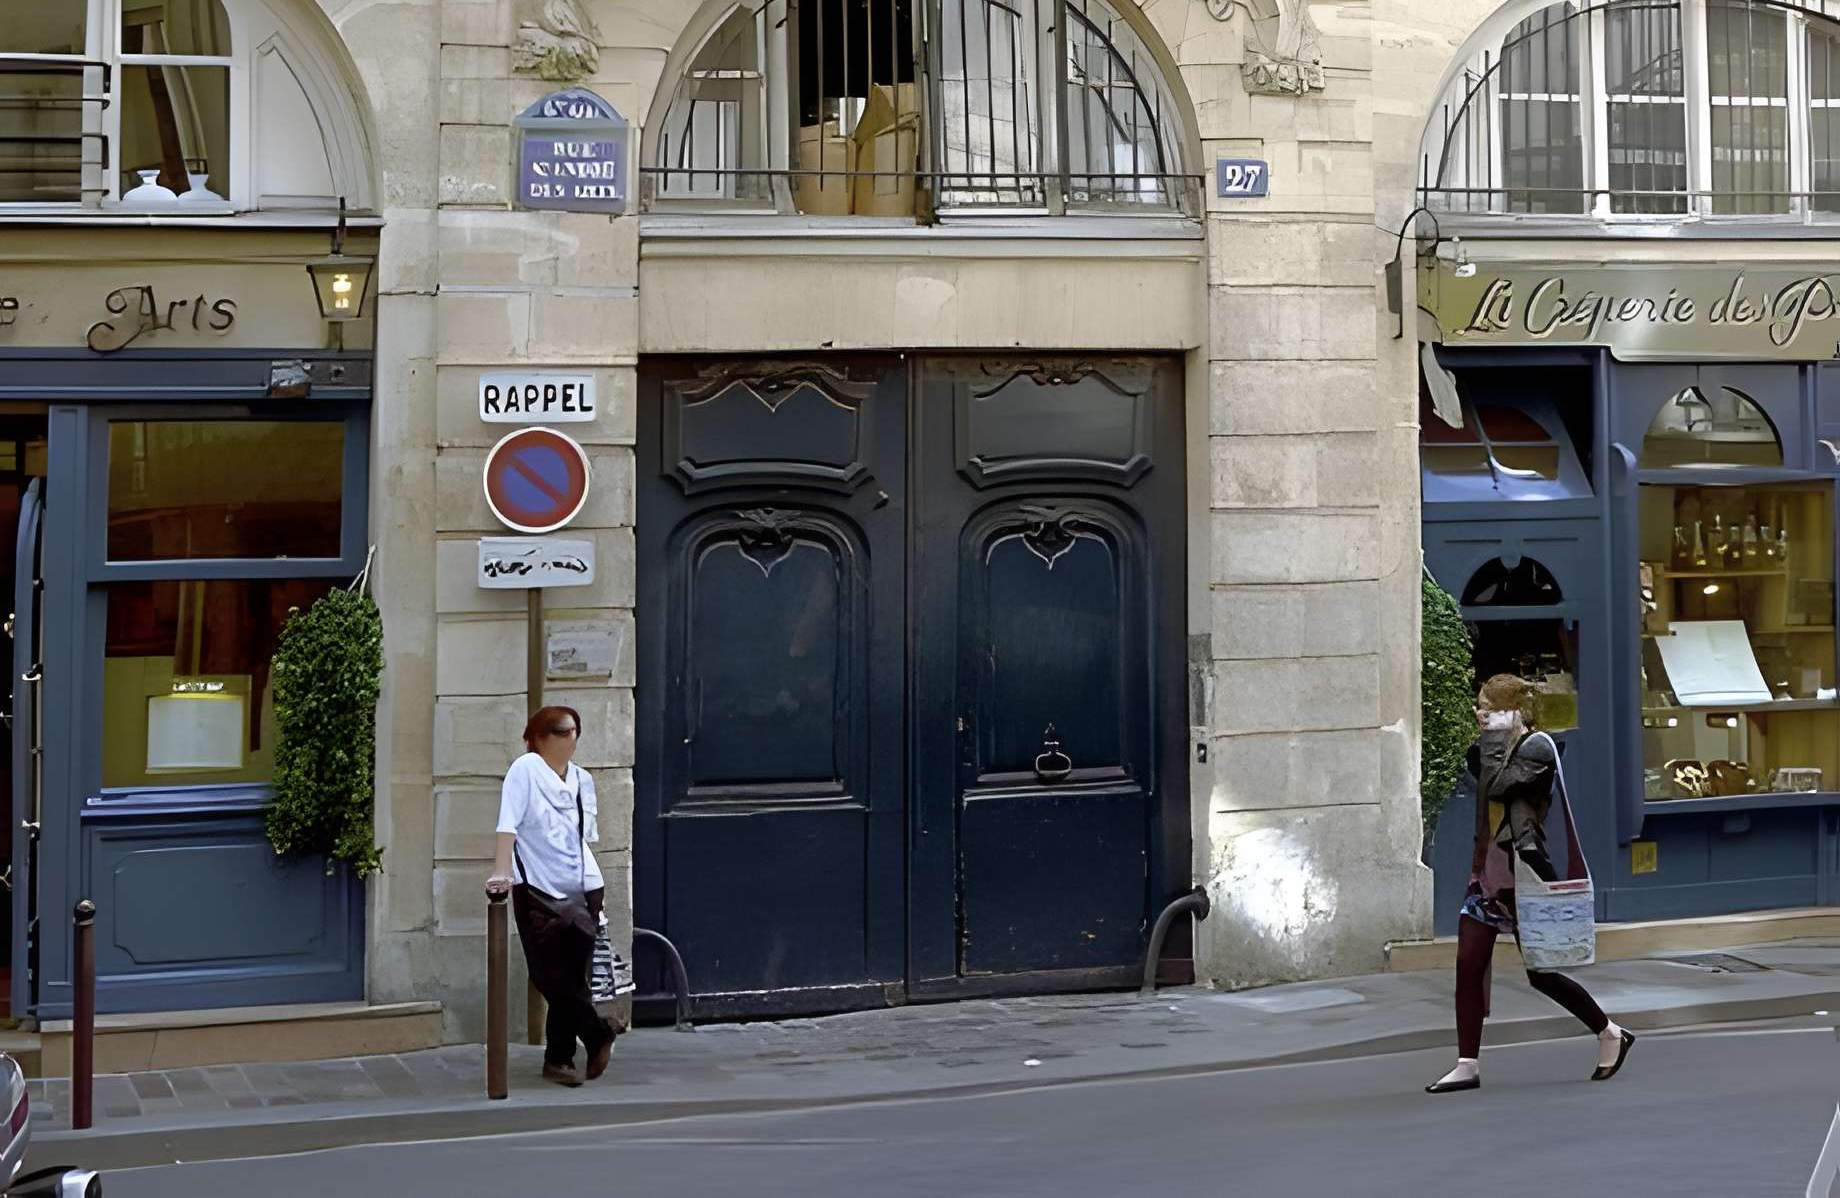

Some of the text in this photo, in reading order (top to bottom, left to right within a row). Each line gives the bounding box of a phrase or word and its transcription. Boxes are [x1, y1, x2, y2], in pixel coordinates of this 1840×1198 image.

[1225, 165, 1262, 193] 27
[86, 284, 238, 352] Arts
[1708, 268, 1769, 325] des
[1768, 273, 1840, 347] P
[483, 382, 595, 414] RAPPEL
